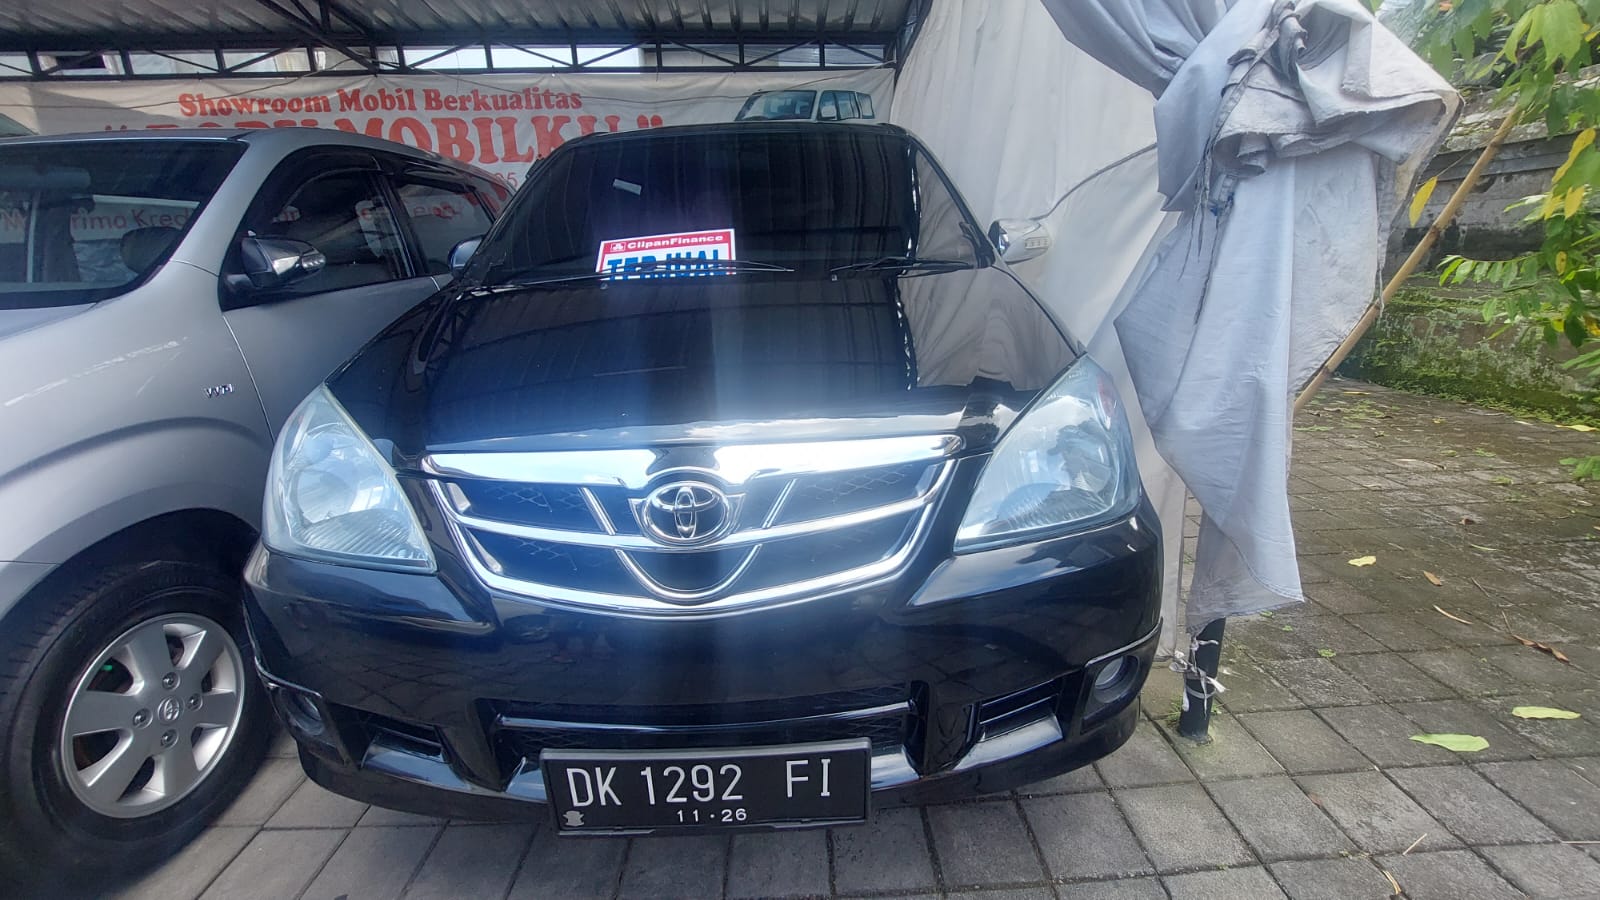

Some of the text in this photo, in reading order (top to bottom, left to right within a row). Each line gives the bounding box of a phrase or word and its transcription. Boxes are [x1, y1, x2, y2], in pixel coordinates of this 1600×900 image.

[178, 86, 582, 117] Showroom Mobil Berkualitas
[132, 209, 190, 228] Kred
[627, 234, 724, 250] ClipanFinance
[566, 758, 831, 807] DK 1292 FI
